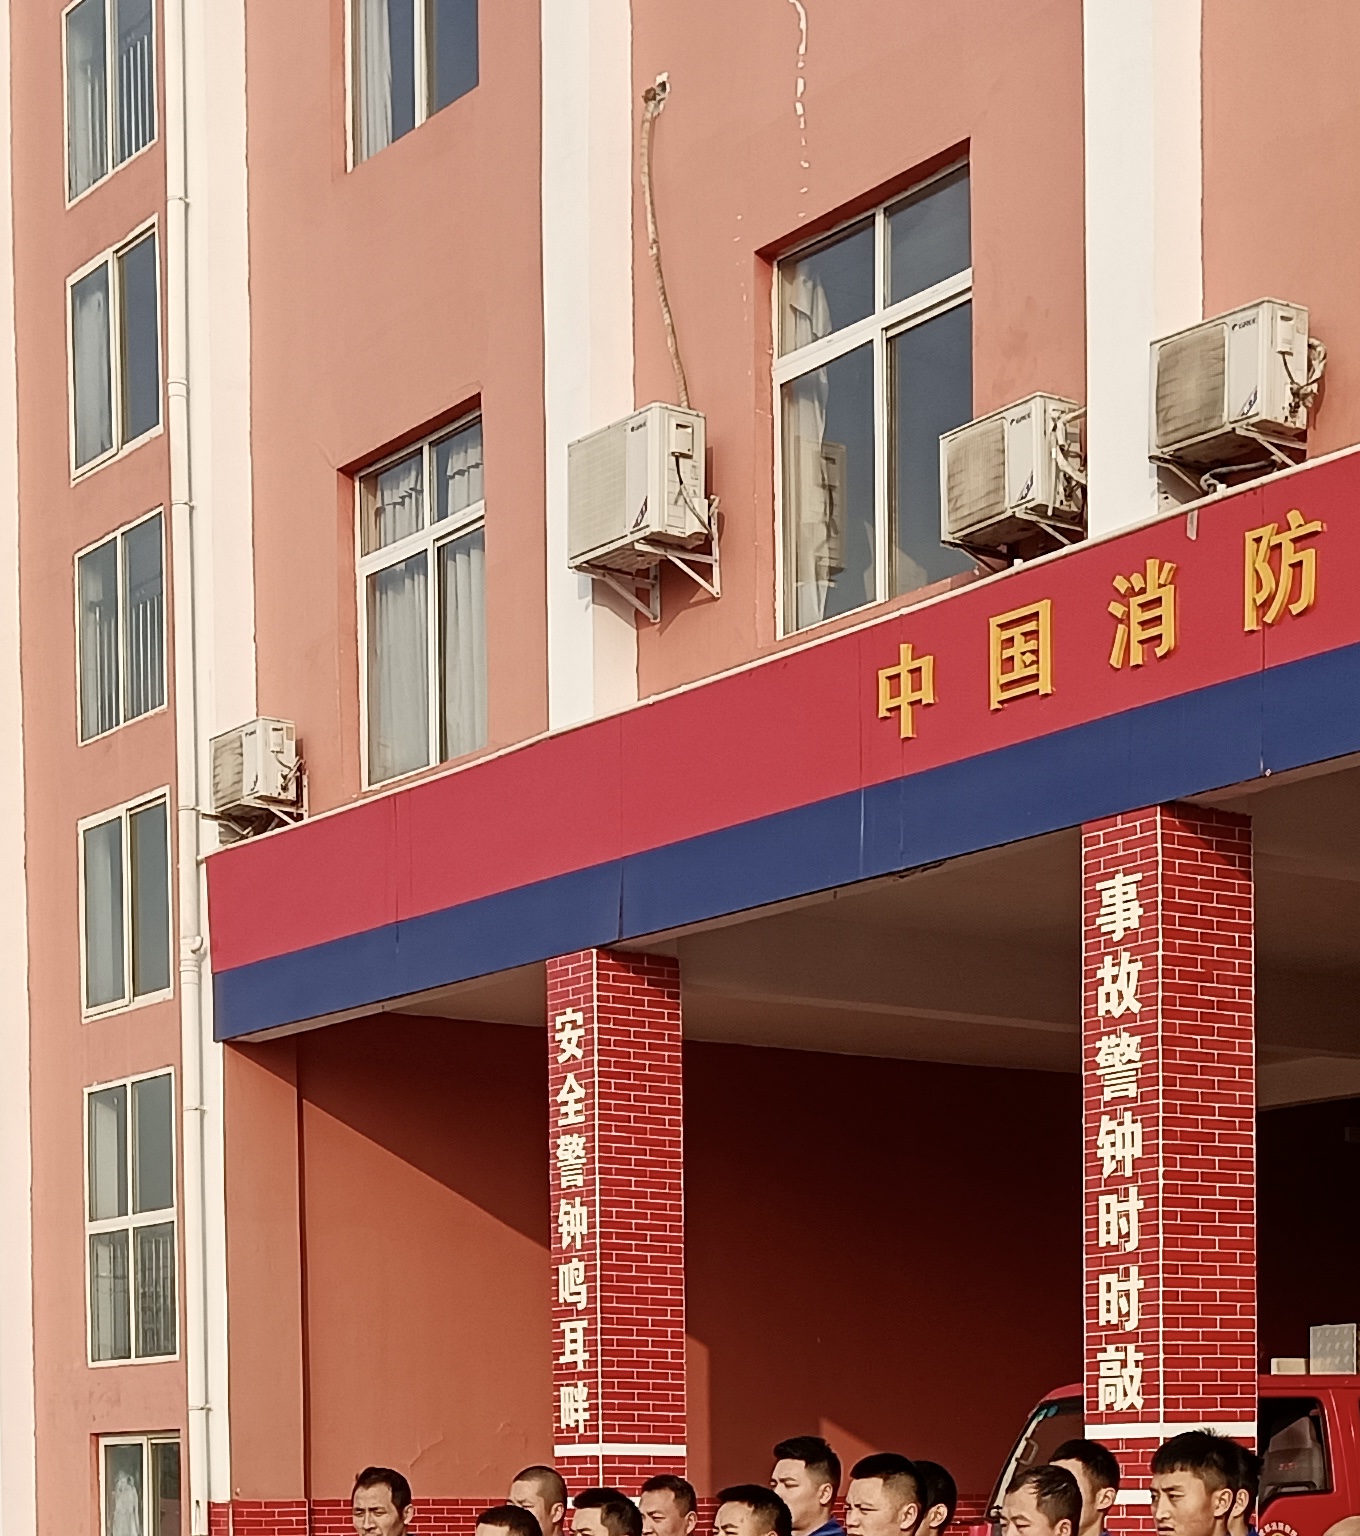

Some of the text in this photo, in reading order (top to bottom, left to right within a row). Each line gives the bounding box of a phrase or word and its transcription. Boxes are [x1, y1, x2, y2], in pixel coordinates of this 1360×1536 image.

[554, 1004, 590, 1436] 安全警钟鸣耳畔
[1094, 869, 1146, 1412] 事故警钟时时敲
